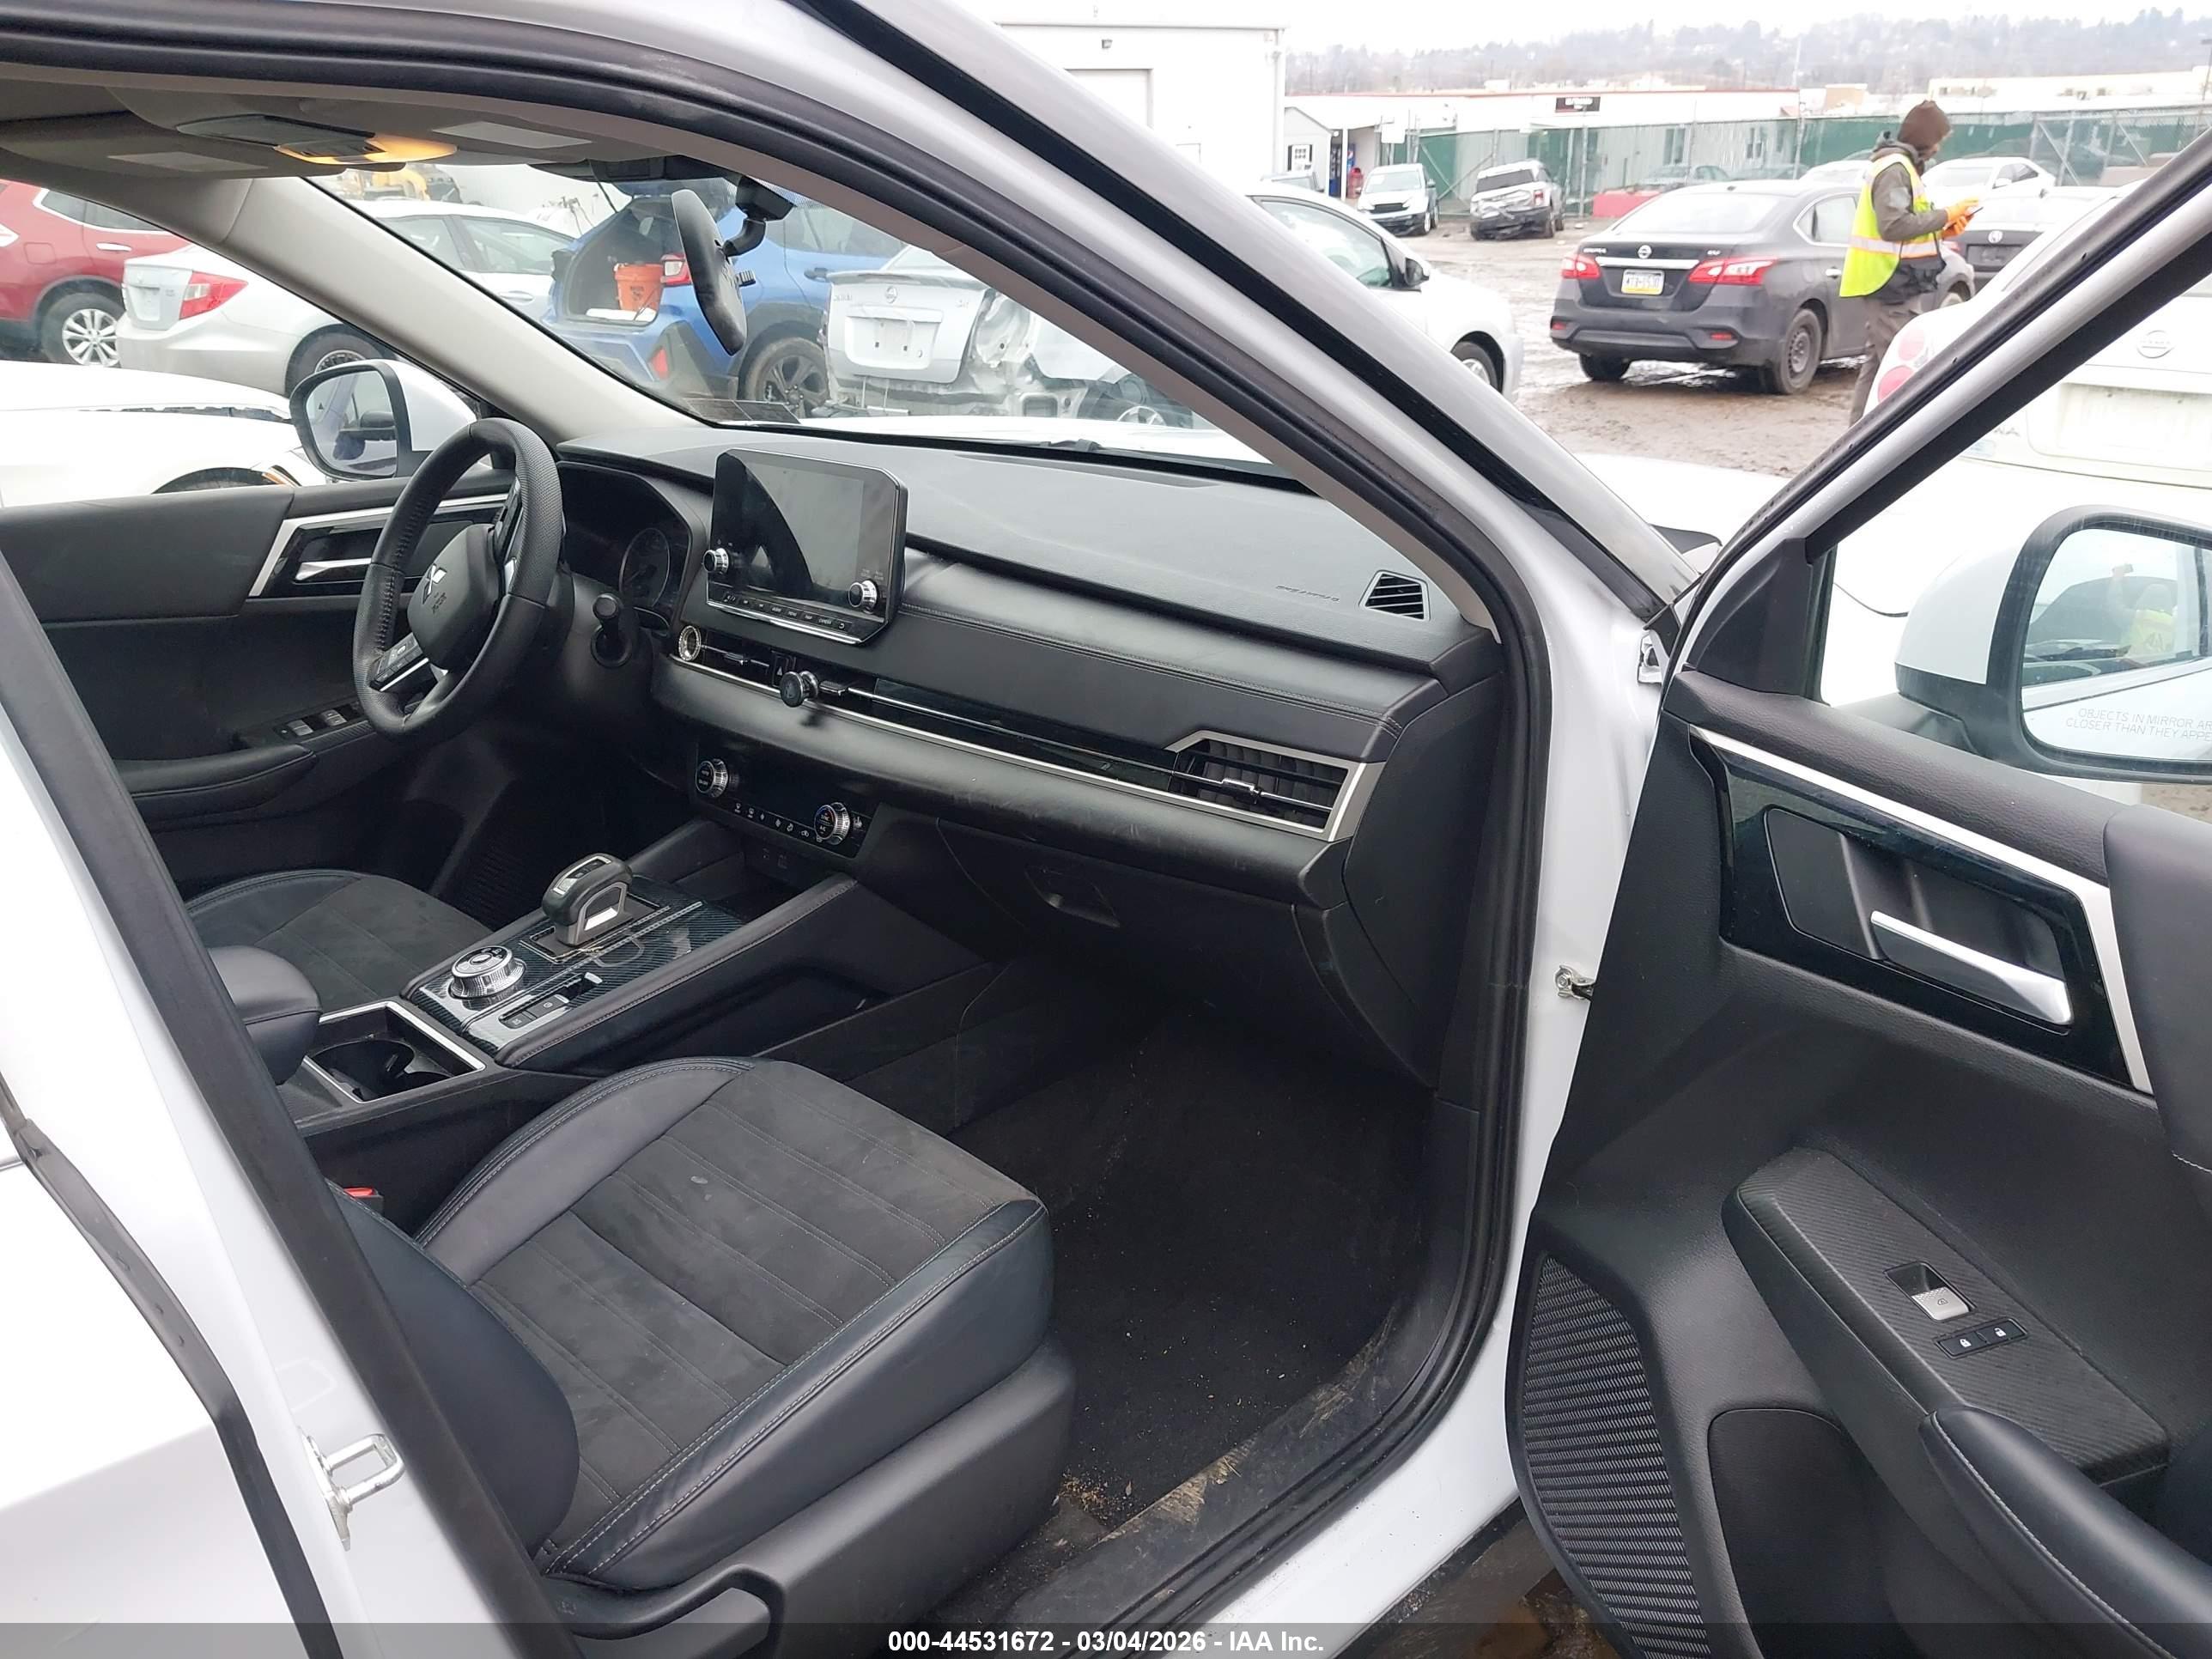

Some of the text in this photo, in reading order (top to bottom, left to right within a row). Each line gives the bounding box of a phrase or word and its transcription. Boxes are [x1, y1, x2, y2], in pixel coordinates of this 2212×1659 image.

[2065, 717, 2111, 730] CLOSER
[2115, 722, 2146, 734] THAN
[2149, 726, 2178, 738] THEY
[2078, 708, 2129, 722] OBJECTS
[2131, 714, 2145, 723] IN
[2147, 714, 2193, 728] MIRROR
